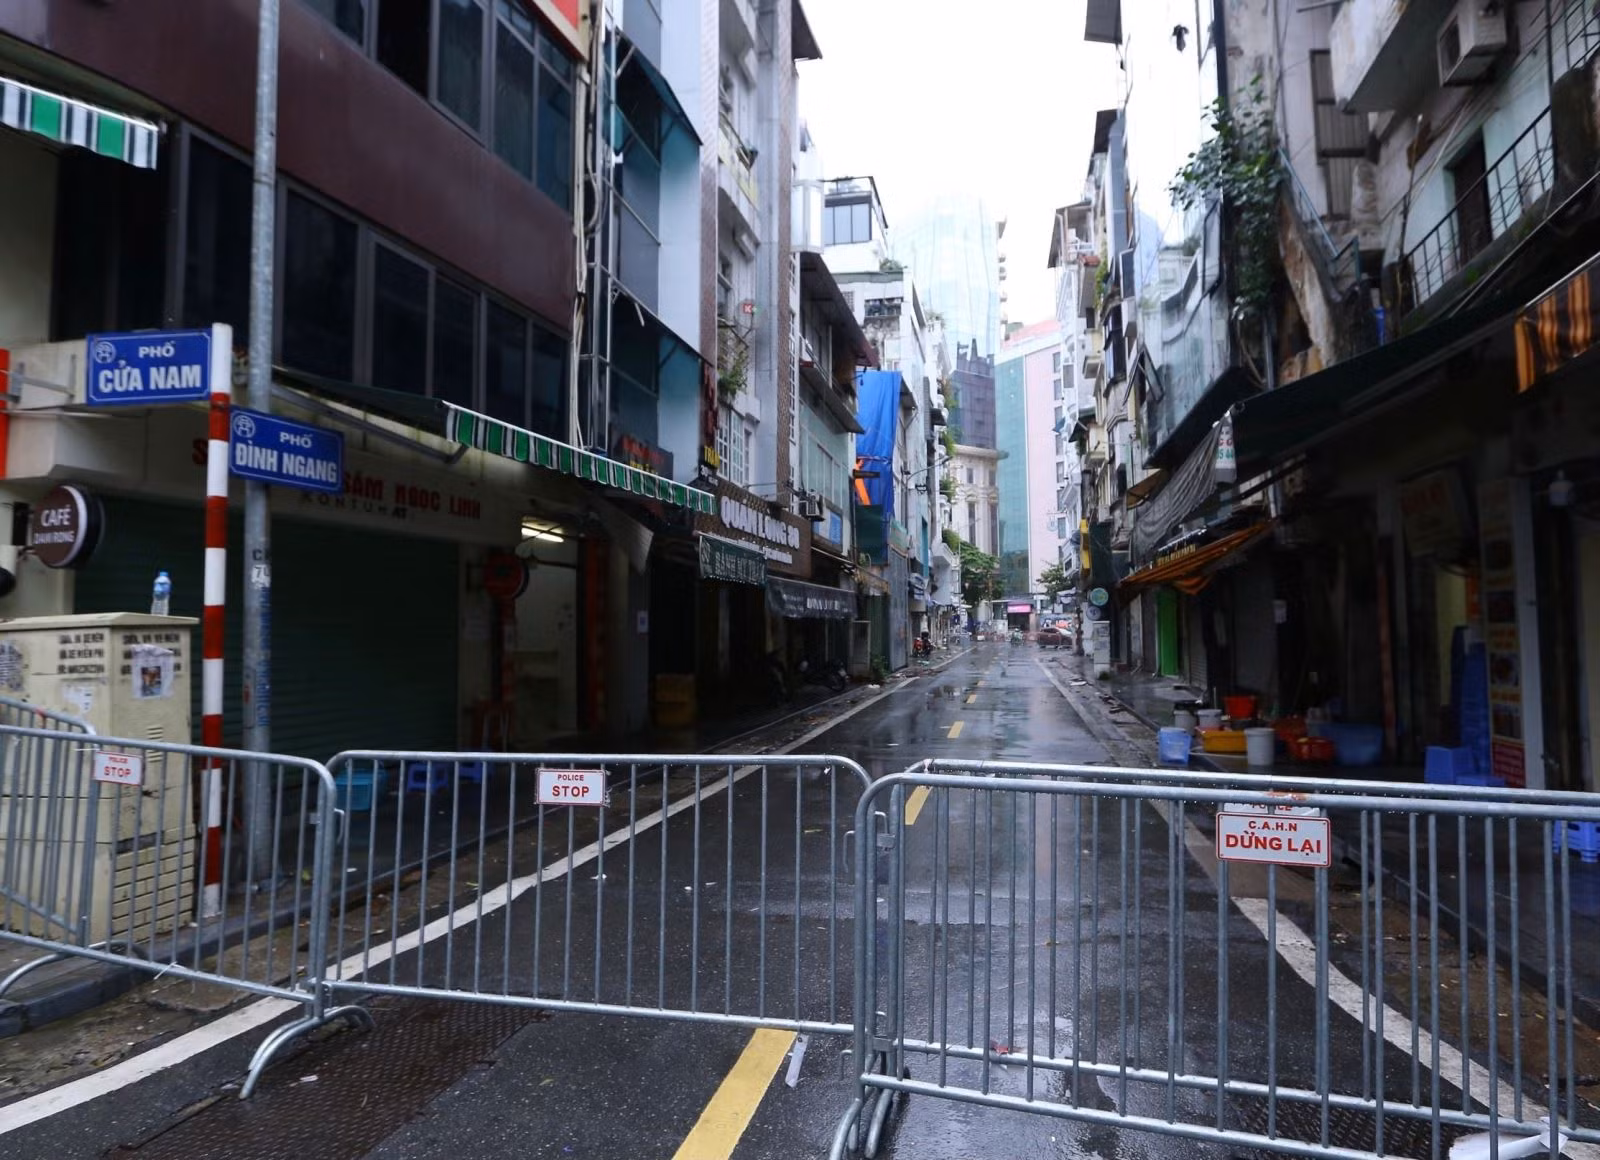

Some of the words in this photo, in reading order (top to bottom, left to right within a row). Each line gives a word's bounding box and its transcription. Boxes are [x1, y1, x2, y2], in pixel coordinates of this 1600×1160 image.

[138, 340, 176, 359] PHỐ
[98, 360, 144, 393] CỬA
[149, 364, 203, 390] NAM
[279, 431, 313, 449] PHỐ
[235, 440, 279, 473] ĐÌNH
[282, 452, 338, 484] NGANG
[104, 766, 131, 777] STOP
[552, 785, 590, 798] STOP
[1248, 820, 1298, 832] C.A.H.N
[1225, 829, 1283, 851] DỪNG
[1287, 838, 1322, 856] LẠI
